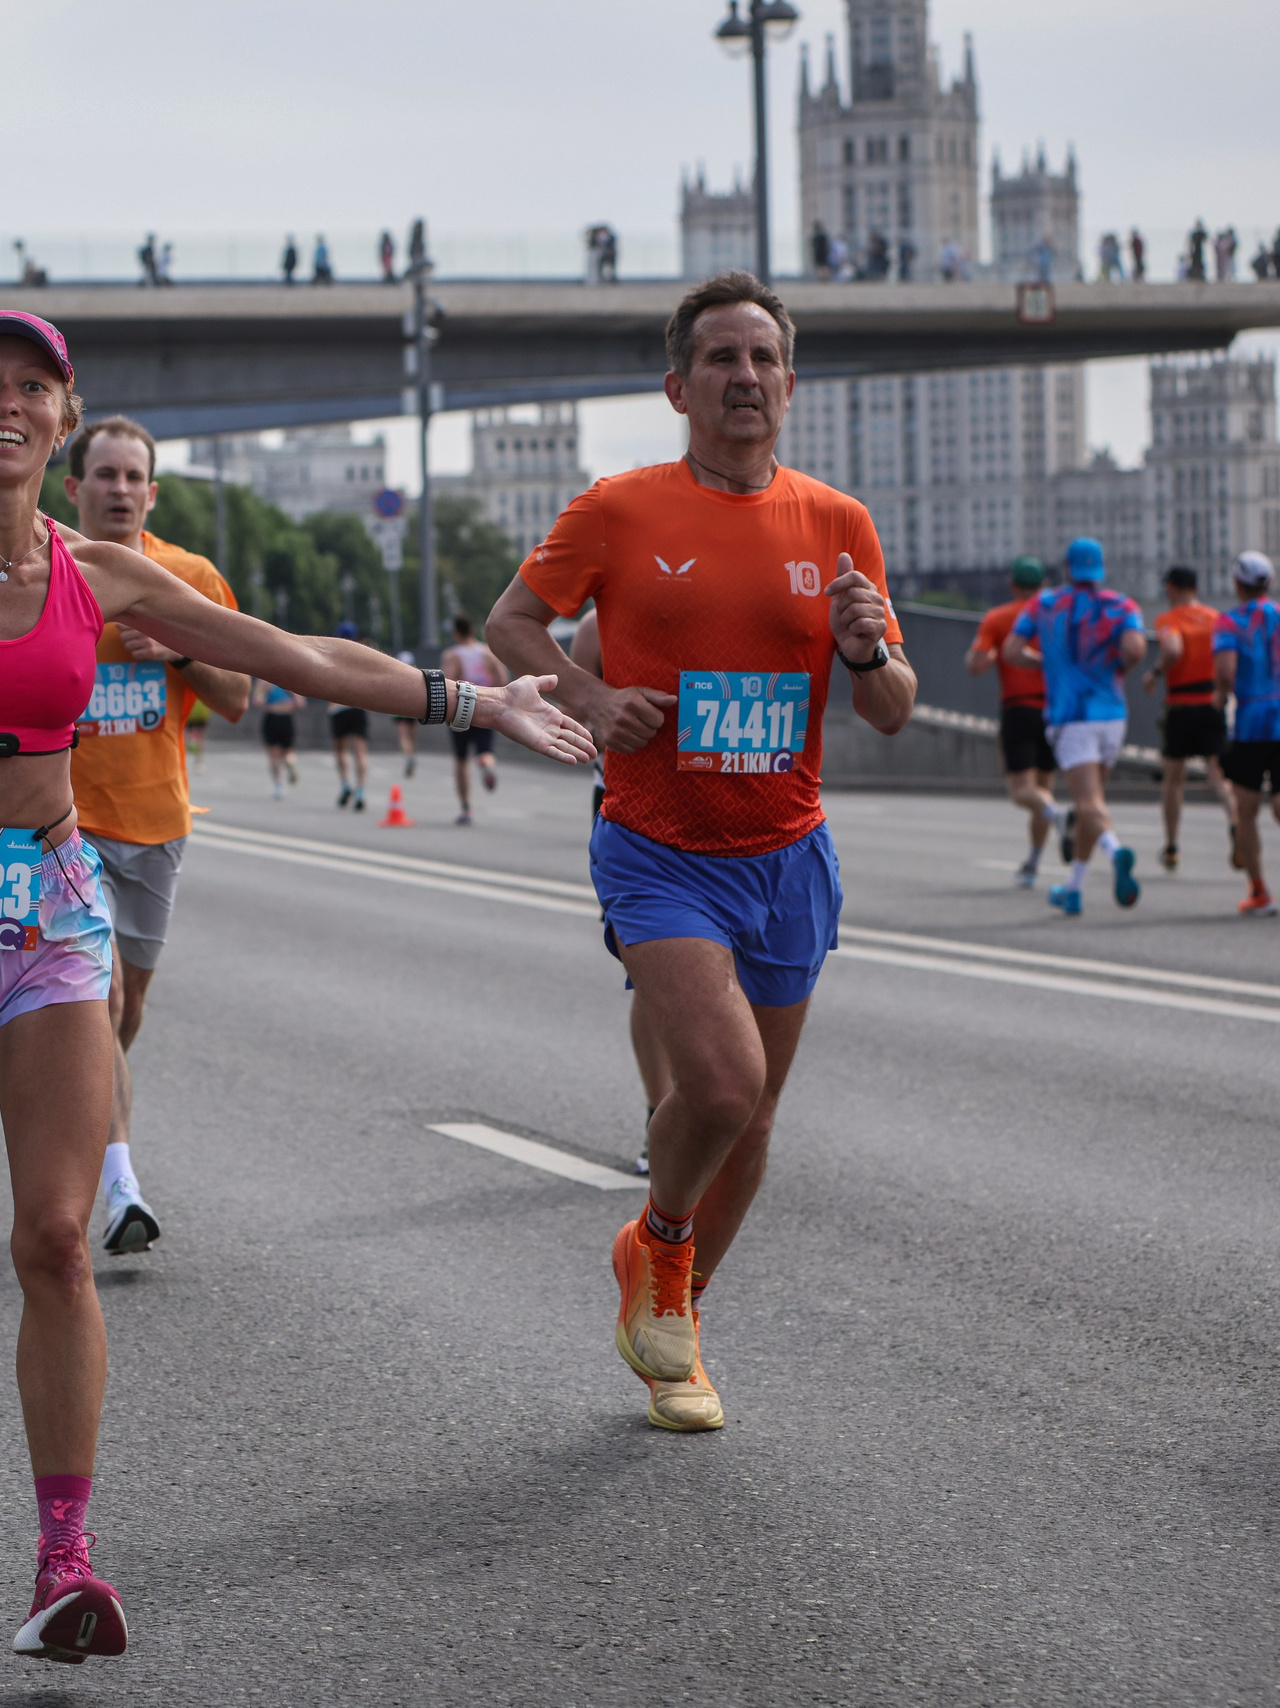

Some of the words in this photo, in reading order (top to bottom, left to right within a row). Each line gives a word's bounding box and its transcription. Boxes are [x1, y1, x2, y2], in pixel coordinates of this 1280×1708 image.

[784, 560, 821, 597] 10
[694, 681, 713, 690] ПСБ
[740, 675, 762, 698] 10
[79, 680, 161, 719] 6663
[142, 710, 159, 727] D
[696, 700, 795, 749] 74411
[720, 751, 771, 773] 21.1KM
[773, 752, 791, 773] C
